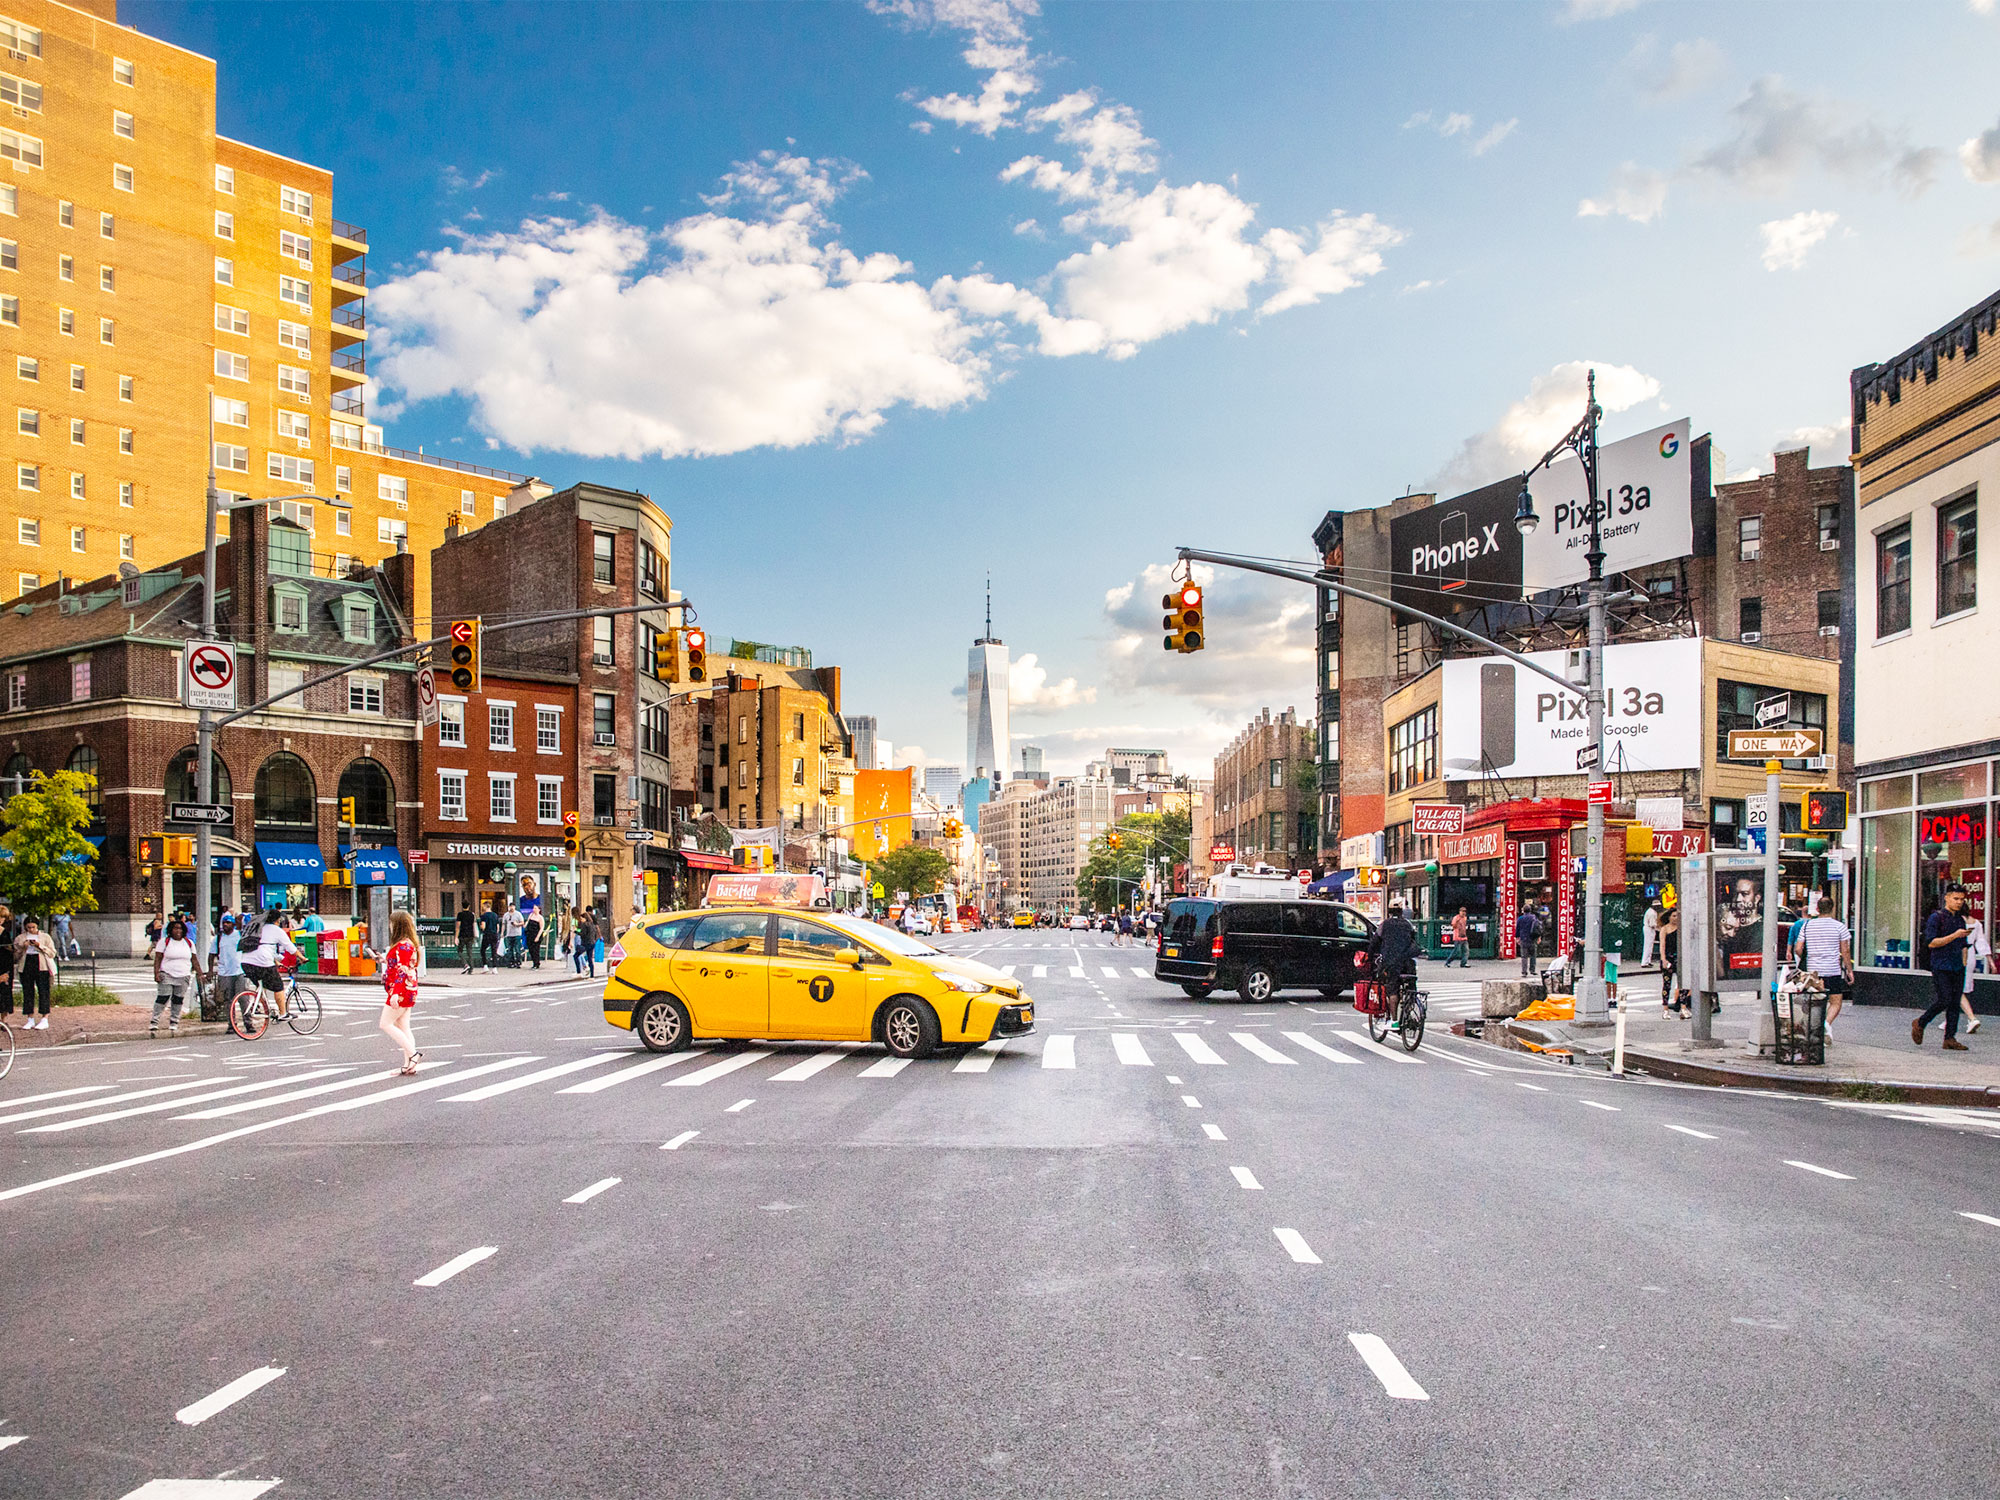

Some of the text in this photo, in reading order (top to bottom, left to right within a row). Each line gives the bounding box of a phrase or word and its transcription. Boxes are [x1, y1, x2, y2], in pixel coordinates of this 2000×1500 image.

[1618, 484, 1650, 515] 3a
[1565, 521, 1640, 550] All-D Battery
[1412, 522, 1500, 576] Phone X
[1622, 687, 1664, 717] 3a
[1773, 703, 1784, 716] WAY
[1550, 728, 1584, 739] Made
[1603, 723, 1649, 737] Google
[1742, 739, 1807, 750] ONE WAY
[180, 808, 225, 818] ONE WAY
[1416, 809, 1461, 820] VILLAGE
[1750, 810, 1767, 822] 20
[1415, 819, 1460, 833] CIGARS
[1931, 813, 1971, 843] CVS
[447, 843, 566, 857] STARBUCKS COFFEE
[1443, 833, 1498, 858] VILLAGE CIGARS
[266, 857, 308, 867] CHASE
[1728, 857, 1755, 865] Phone
[739, 883, 759, 899] Hell
[1720, 901, 1764, 910] STRENGTH
[415, 923, 440, 933] ubway
[815, 980, 829, 999] T
